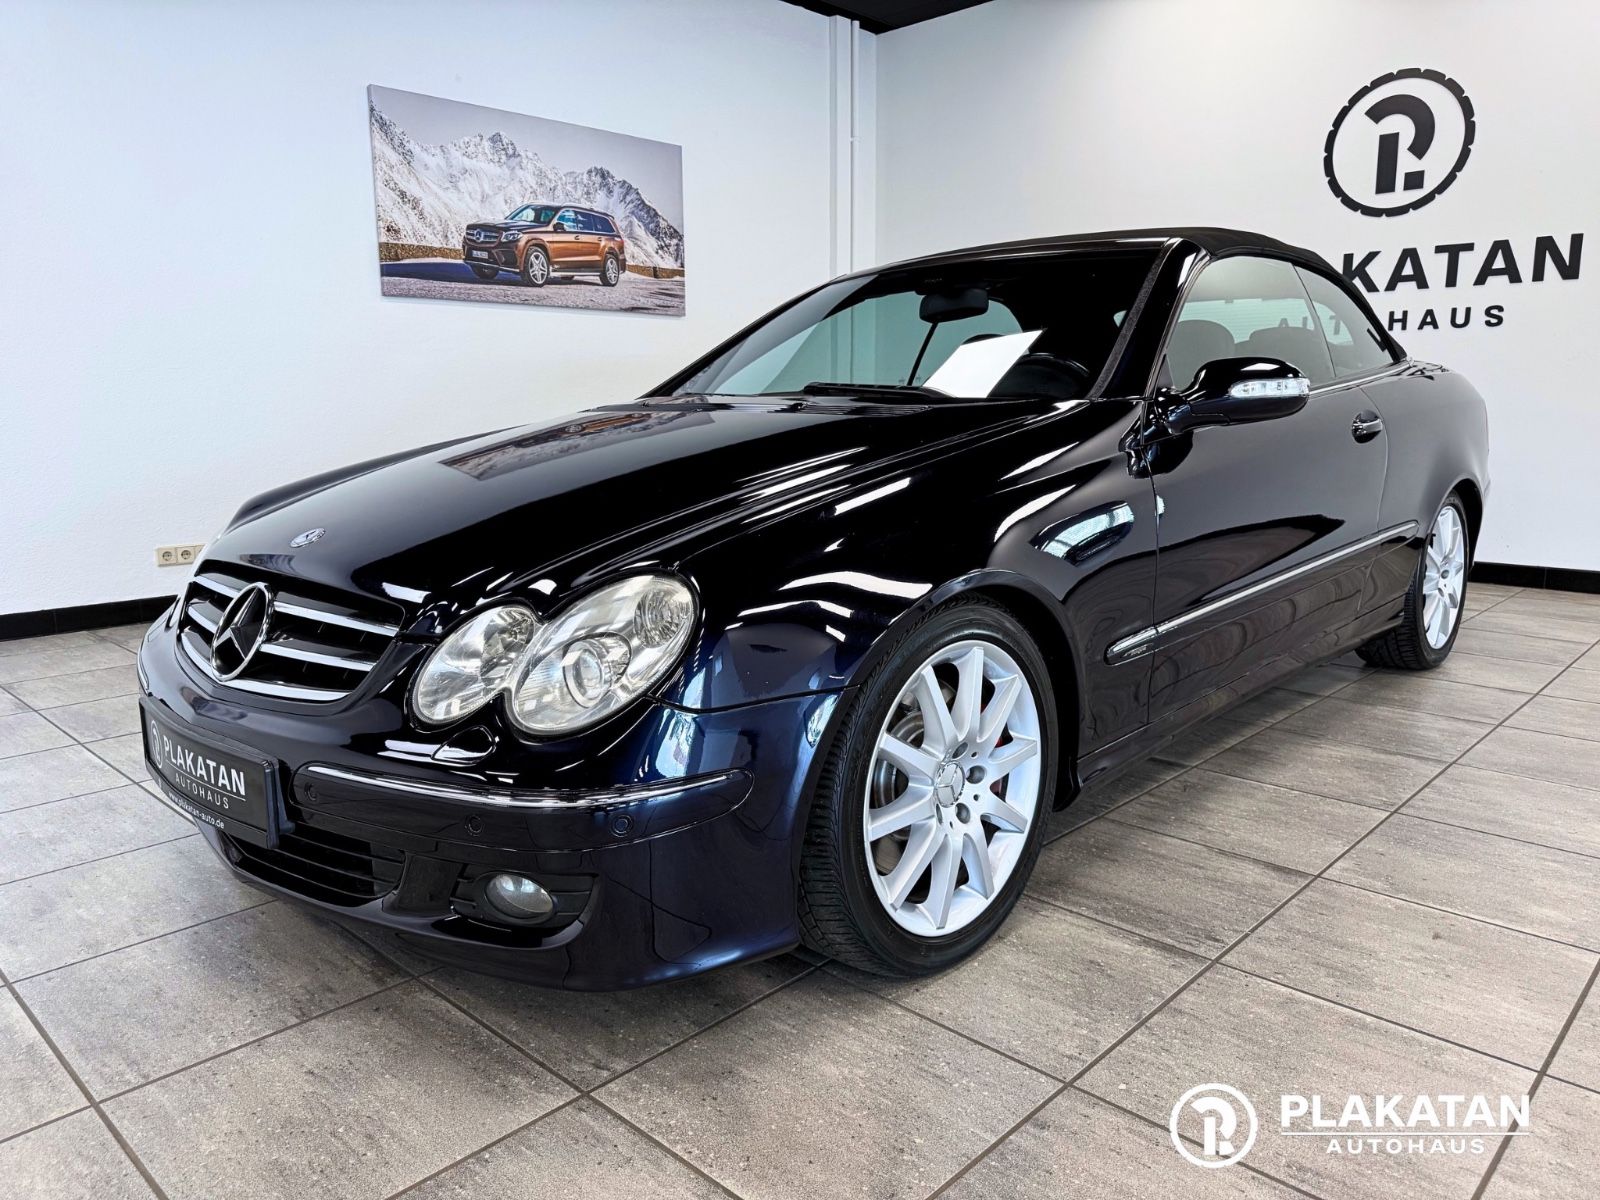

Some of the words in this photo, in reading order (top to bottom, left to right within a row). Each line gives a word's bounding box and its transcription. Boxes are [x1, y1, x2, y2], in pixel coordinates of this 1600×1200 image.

[1343, 233, 1584, 293] KATAN
[163, 735, 246, 796] PLAKATAN
[175, 773, 229, 809] AUTOHAUS
